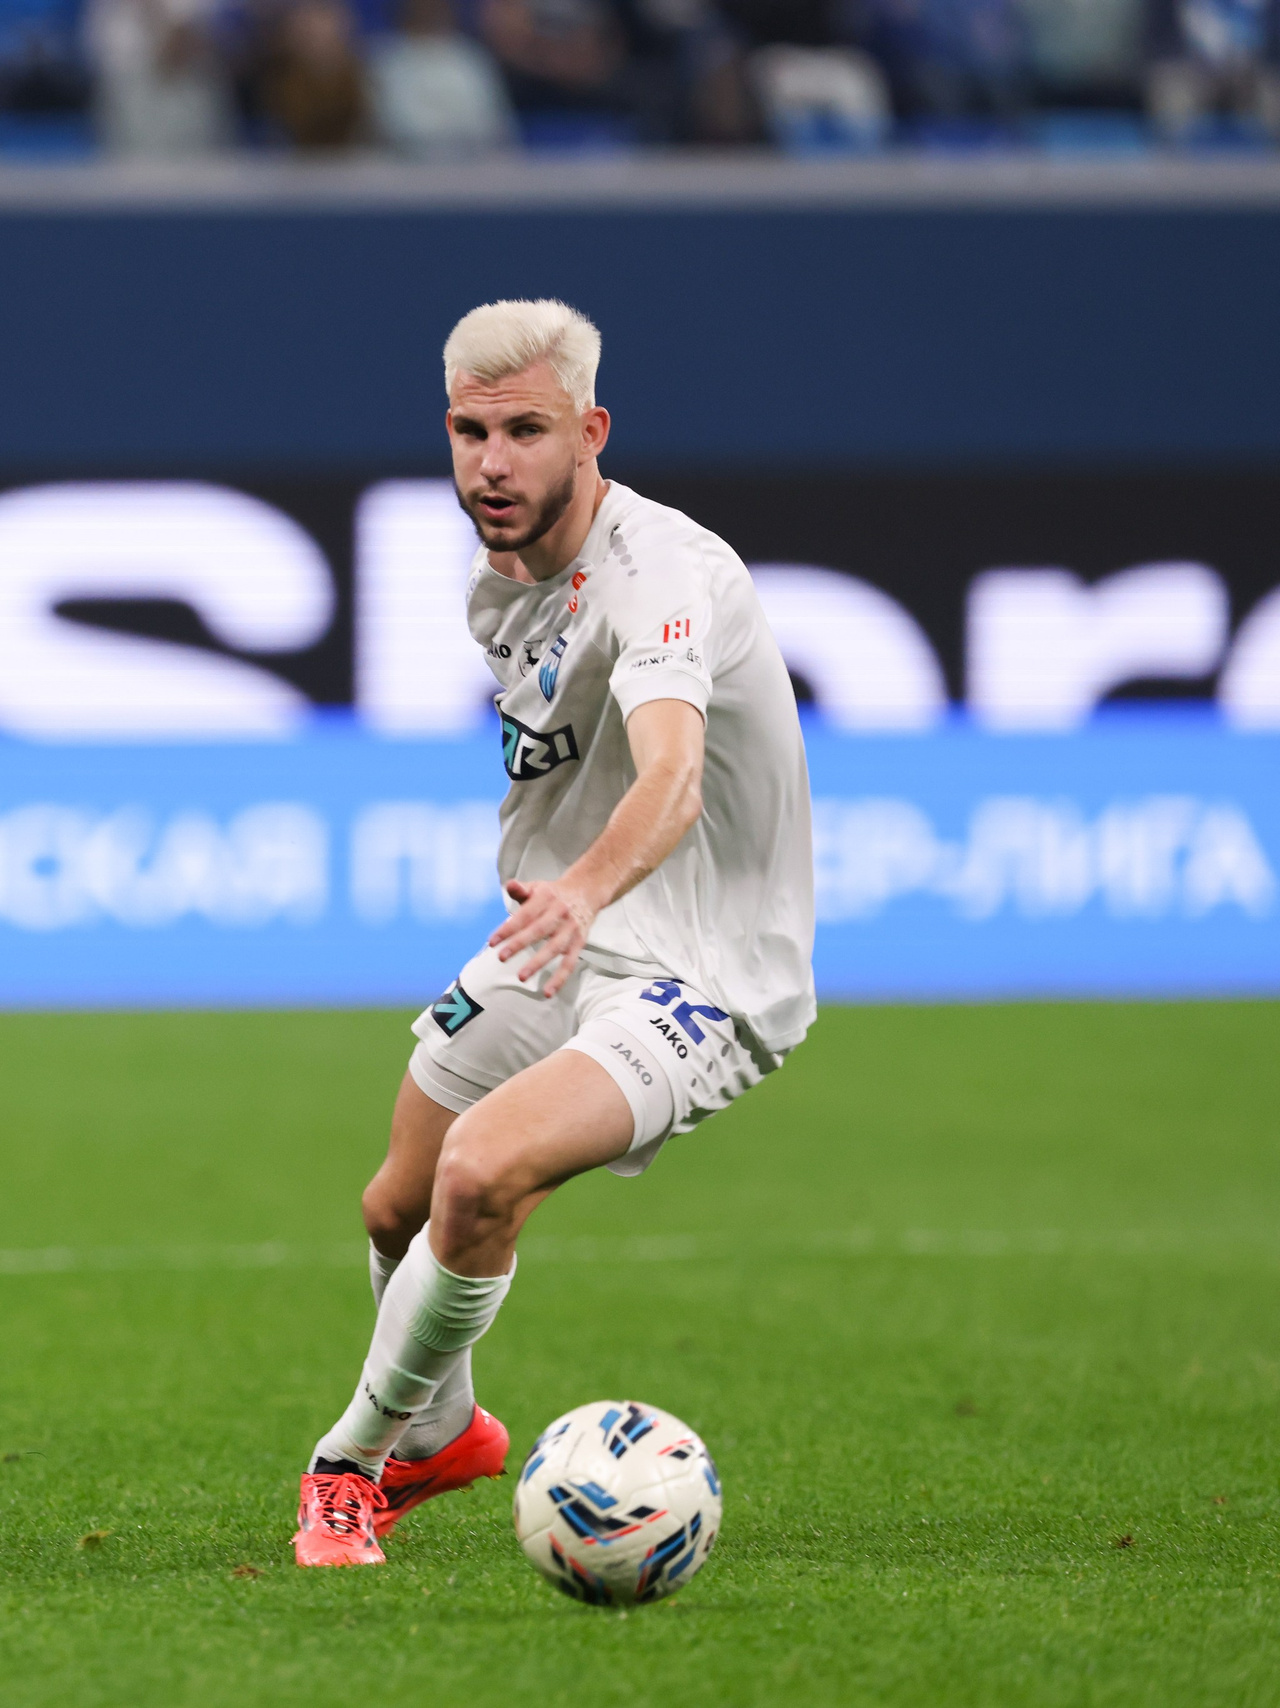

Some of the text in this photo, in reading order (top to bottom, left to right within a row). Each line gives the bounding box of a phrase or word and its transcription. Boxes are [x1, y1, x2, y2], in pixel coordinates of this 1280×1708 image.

[503, 720, 571, 775] ARI
[649, 1017, 688, 1060] JAKO
[610, 1042, 654, 1086] JAKO
